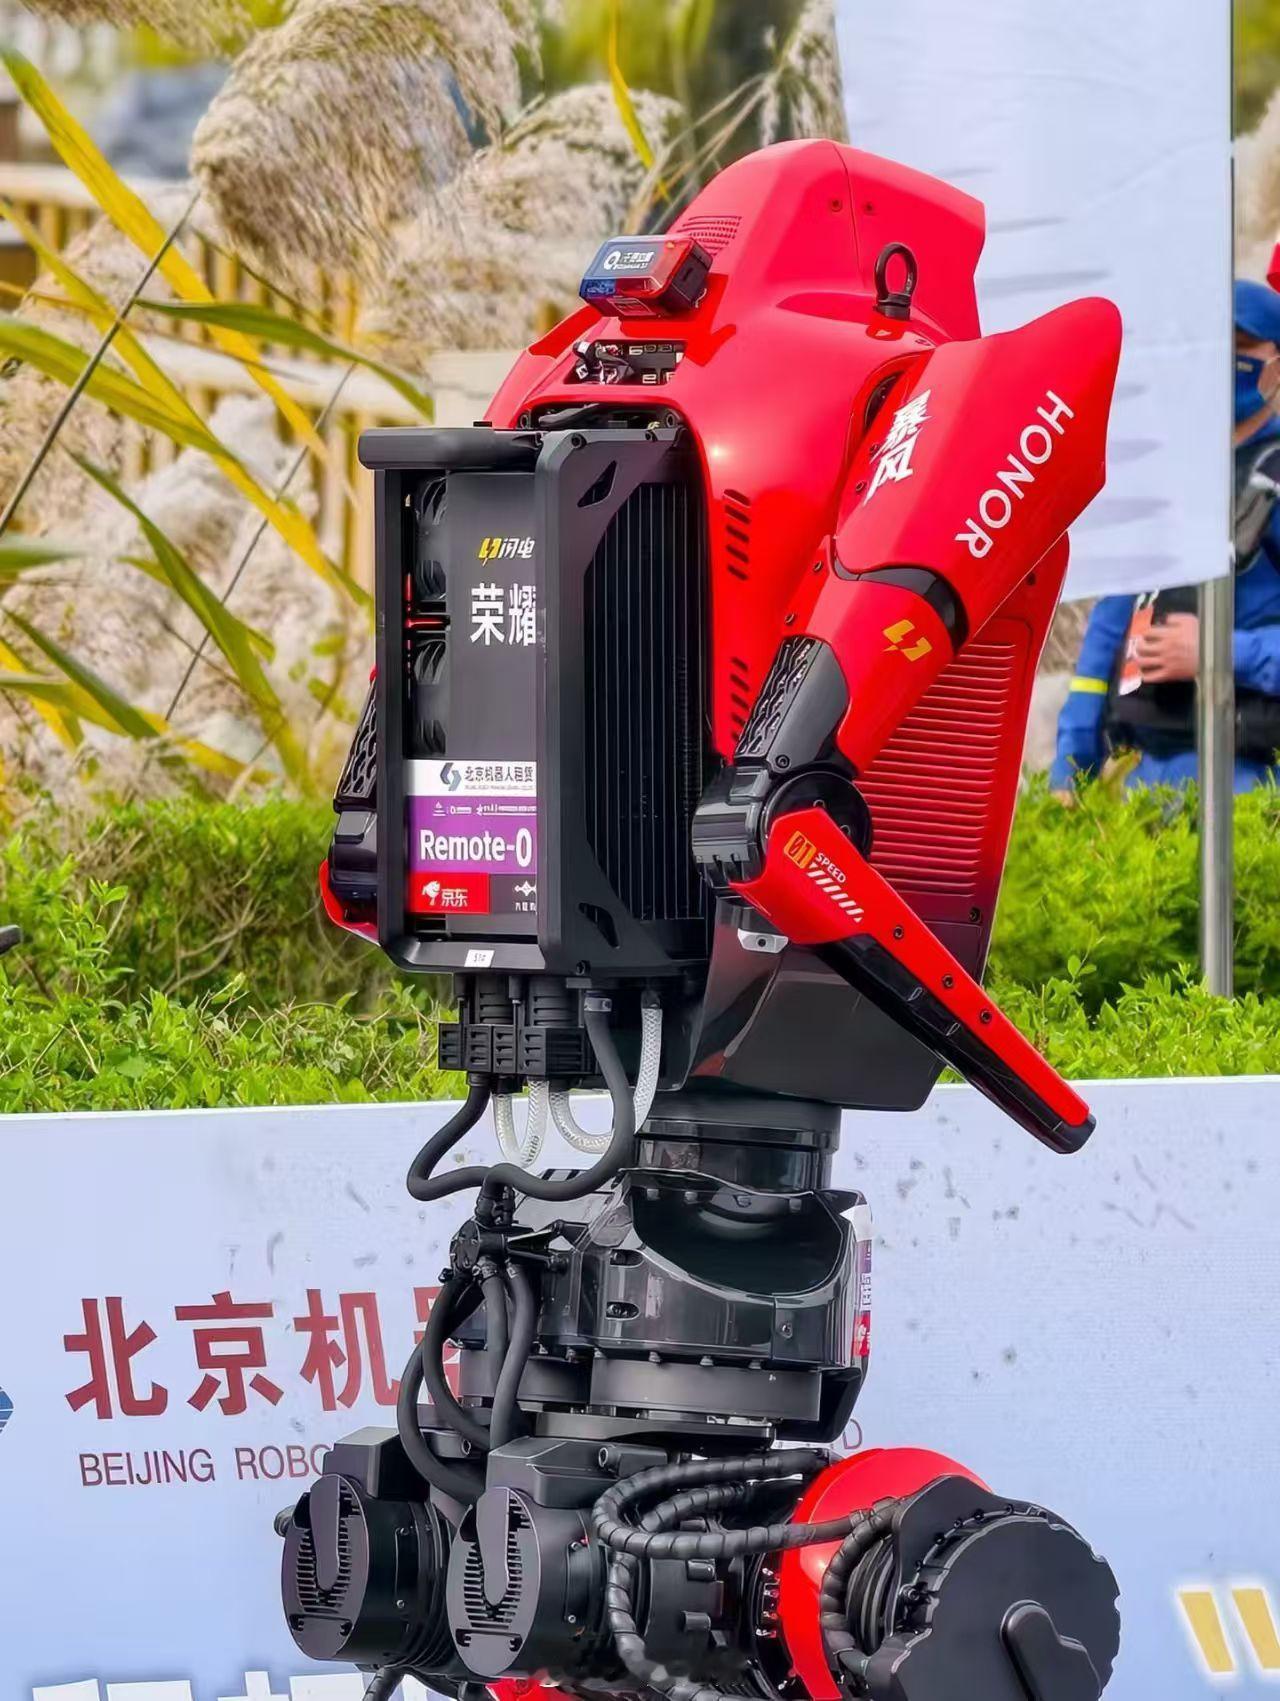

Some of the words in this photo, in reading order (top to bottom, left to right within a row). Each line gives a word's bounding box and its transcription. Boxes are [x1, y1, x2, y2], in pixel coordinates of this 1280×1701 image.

[954, 390, 1075, 559] HONOR
[498, 537, 535, 559] 闪电
[470, 583, 536, 646] 荣耀
[815, 852, 847, 883] SPEED
[441, 888, 468, 907] 京东
[64, 1286, 462, 1419] 北京机
[79, 1448, 216, 1487] BEIJING
